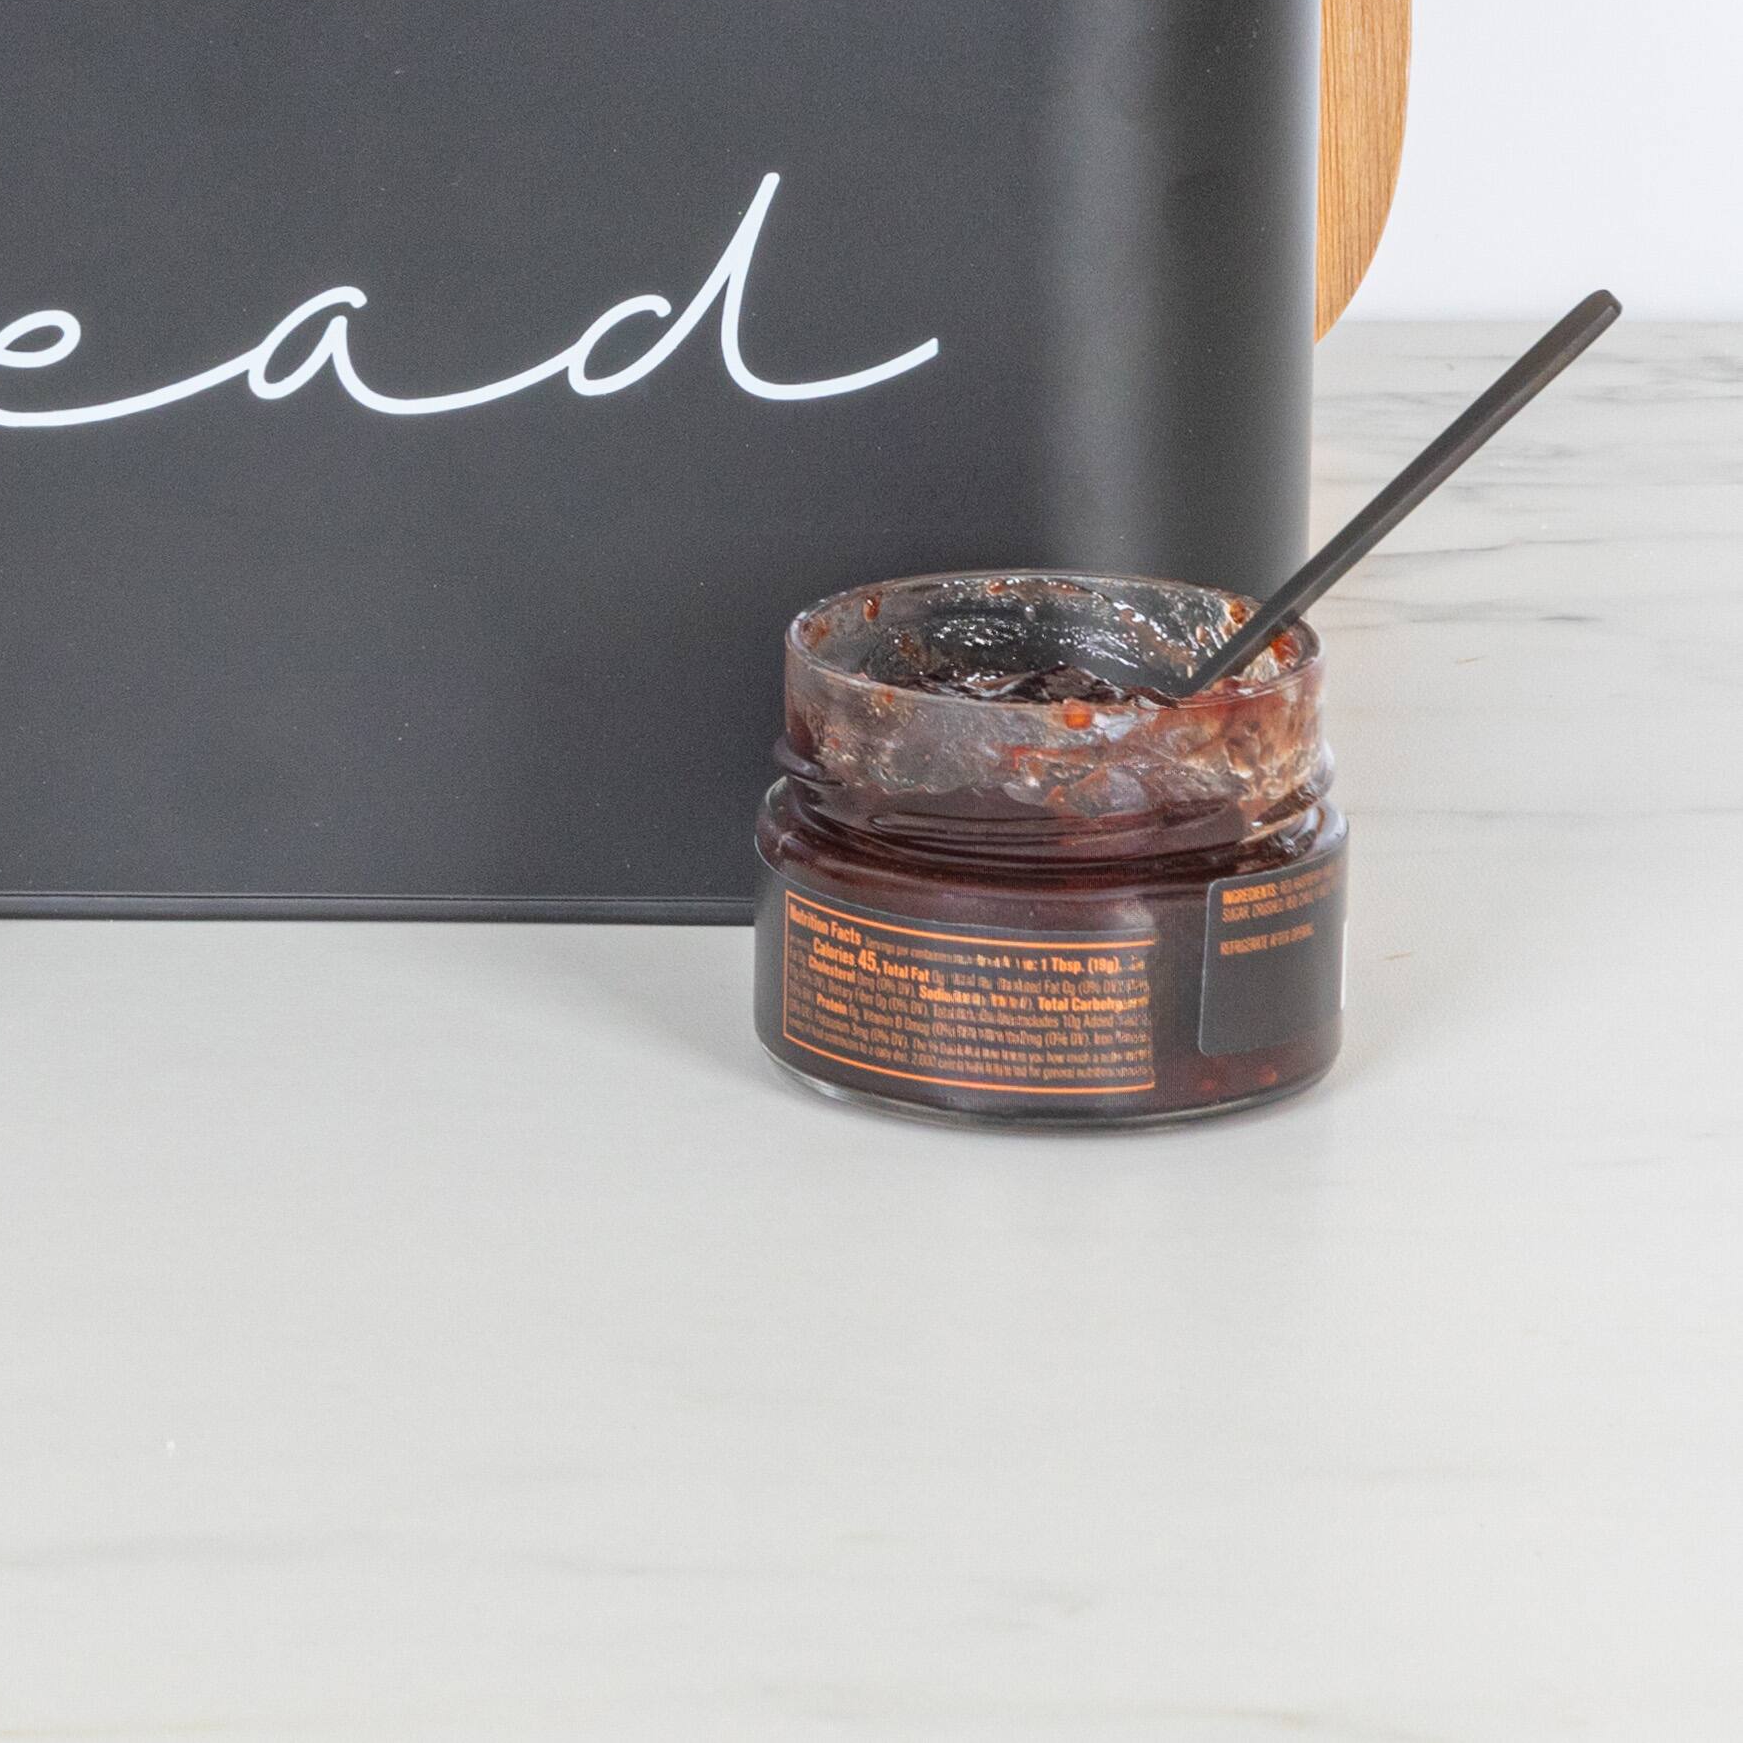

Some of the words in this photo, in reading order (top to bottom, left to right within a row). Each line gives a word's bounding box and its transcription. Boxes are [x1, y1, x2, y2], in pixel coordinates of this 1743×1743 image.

[790, 903, 829, 935] Nutrition
[831, 921, 862, 945] Facts
[813, 936, 856, 966] Calories
[858, 948, 881, 975] 45,
[882, 960, 908, 979] Total
[910, 966, 930, 983] Fat
[1051, 956, 1085, 975] Tbsp.
[816, 993, 847, 1015] Protein
[1038, 994, 1069, 1011] Total
